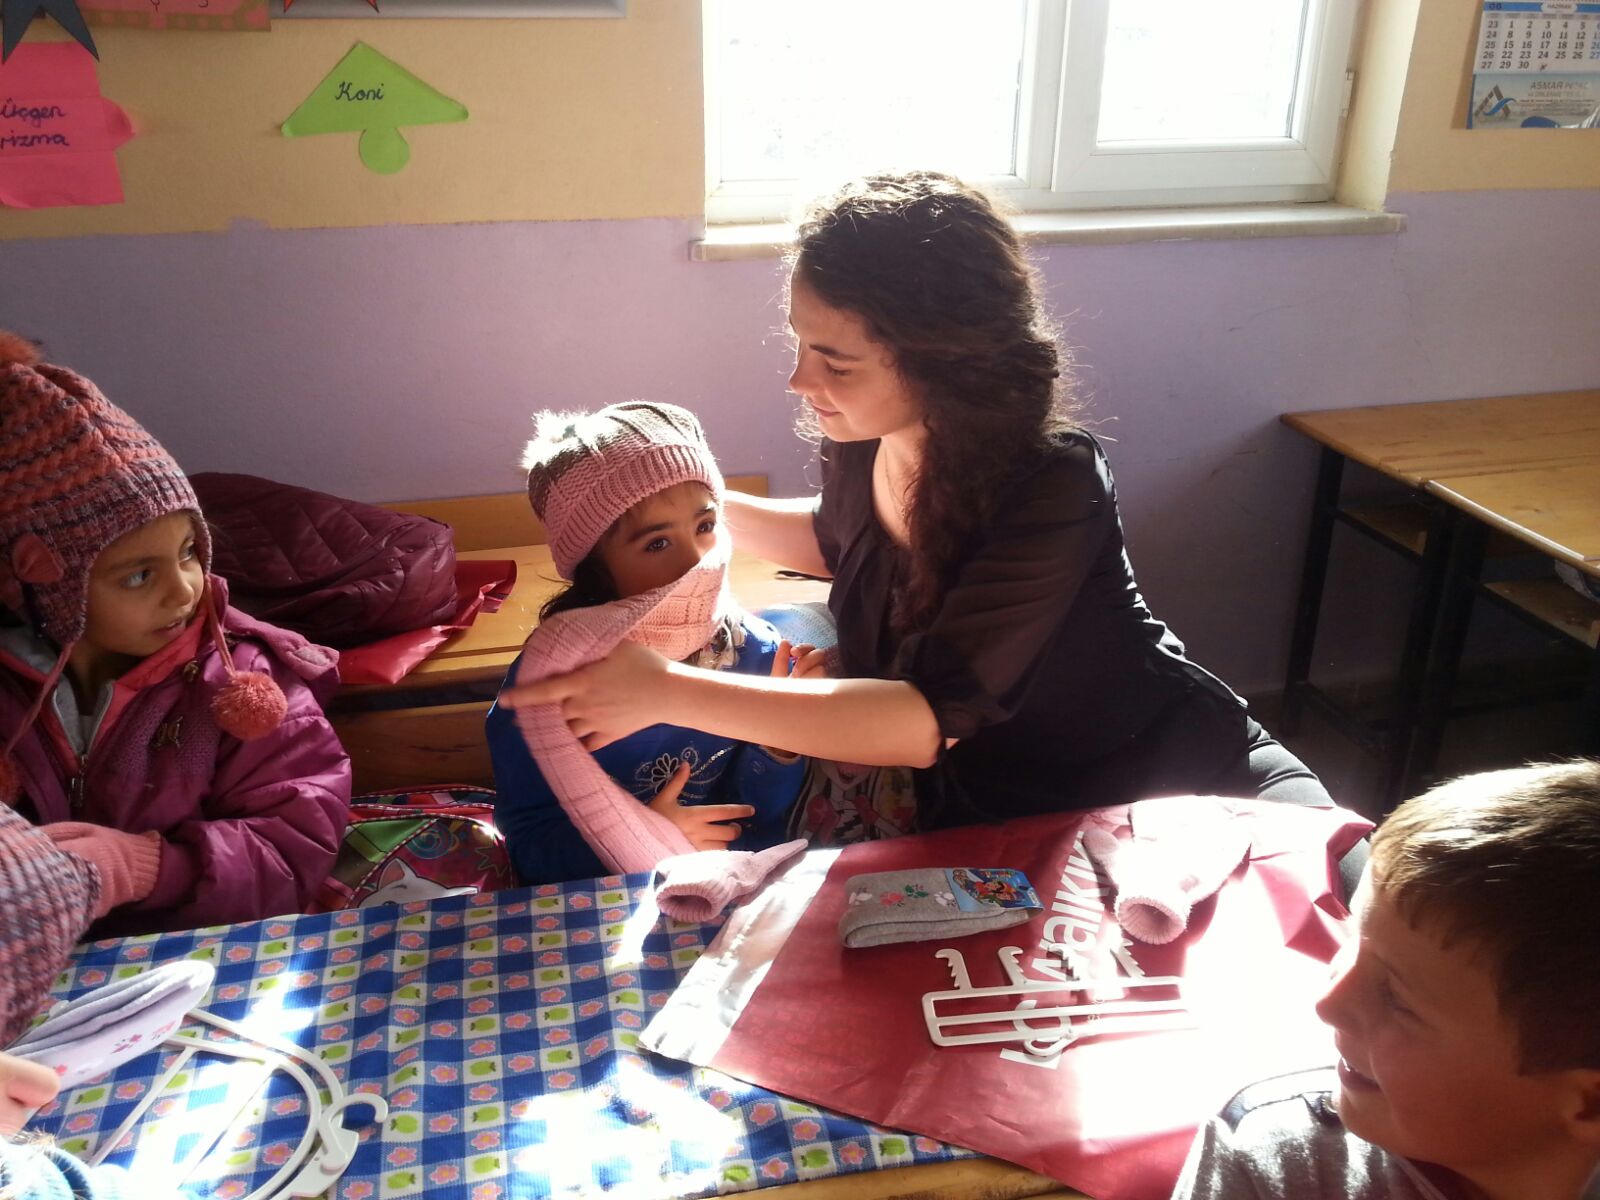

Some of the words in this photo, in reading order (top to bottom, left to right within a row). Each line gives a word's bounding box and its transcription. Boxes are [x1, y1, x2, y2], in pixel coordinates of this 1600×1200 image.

[1487, 21, 1499, 29] 23
[1509, 20, 1514, 29] 1
[1527, 21, 1533, 29] 2
[1545, 21, 1551, 29] 3
[1562, 21, 1568, 29] 4
[1580, 22, 1586, 30] 5
[1486, 31, 1497, 39] 24
[1507, 31, 1513, 39] 8
[1526, 31, 1532, 39] 9
[1541, 31, 1552, 39] 10
[1559, 31, 1568, 39] 11
[1576, 32, 1586, 40] 12
[1485, 41, 1496, 49] 25
[1504, 41, 1514, 49] 15
[1522, 41, 1532, 49] 16
[1540, 41, 1550, 49] 17
[1557, 41, 1567, 49] 18
[1574, 42, 1584, 50] 19
[1483, 51, 1494, 59] 26
[1501, 51, 1513, 59] 22
[1520, 51, 1531, 59] 23
[1538, 51, 1549, 59] 24
[1555, 52, 1566, 60] 25
[1572, 52, 1583, 60] 26
[1481, 61, 1493, 69] 27
[1499, 61, 1511, 69] 29
[1518, 61, 1529, 69] 30
[334, 80, 385, 102] Koni
[0, 129, 71, 151] rizma
